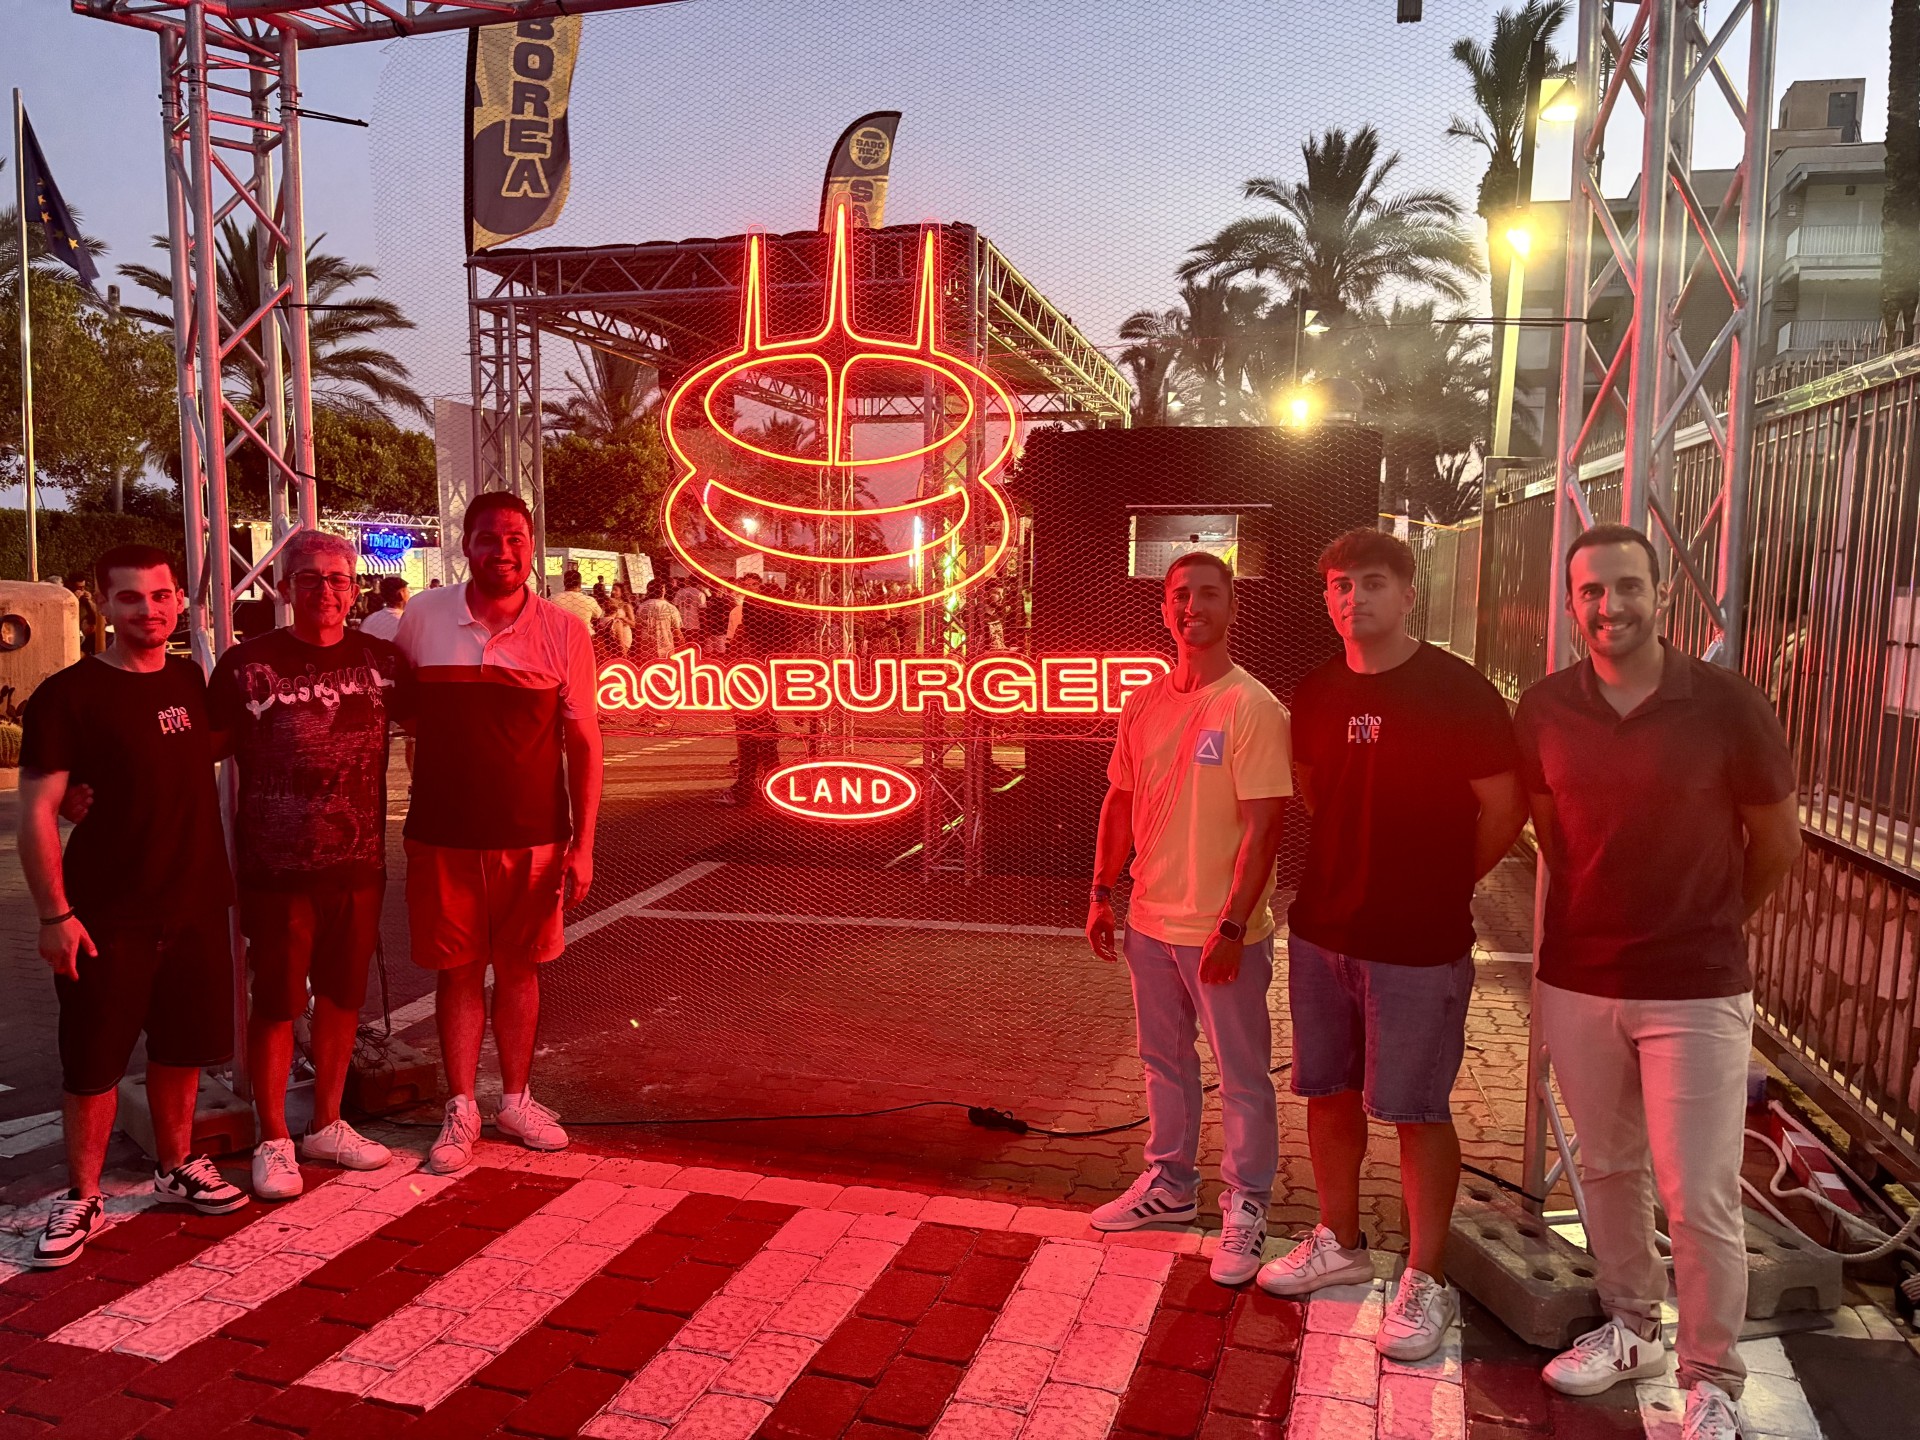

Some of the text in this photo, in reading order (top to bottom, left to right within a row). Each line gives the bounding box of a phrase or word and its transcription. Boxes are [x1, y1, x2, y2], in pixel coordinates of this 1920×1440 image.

[856, 139, 885, 150] SABO
[245, 648, 396, 719] Desigual
[158, 706, 187, 719] acho
[1348, 713, 1382, 726] acho
[160, 714, 191, 731] LIVE
[1347, 725, 1380, 739] LIVE
[789, 776, 891, 804] LAND
